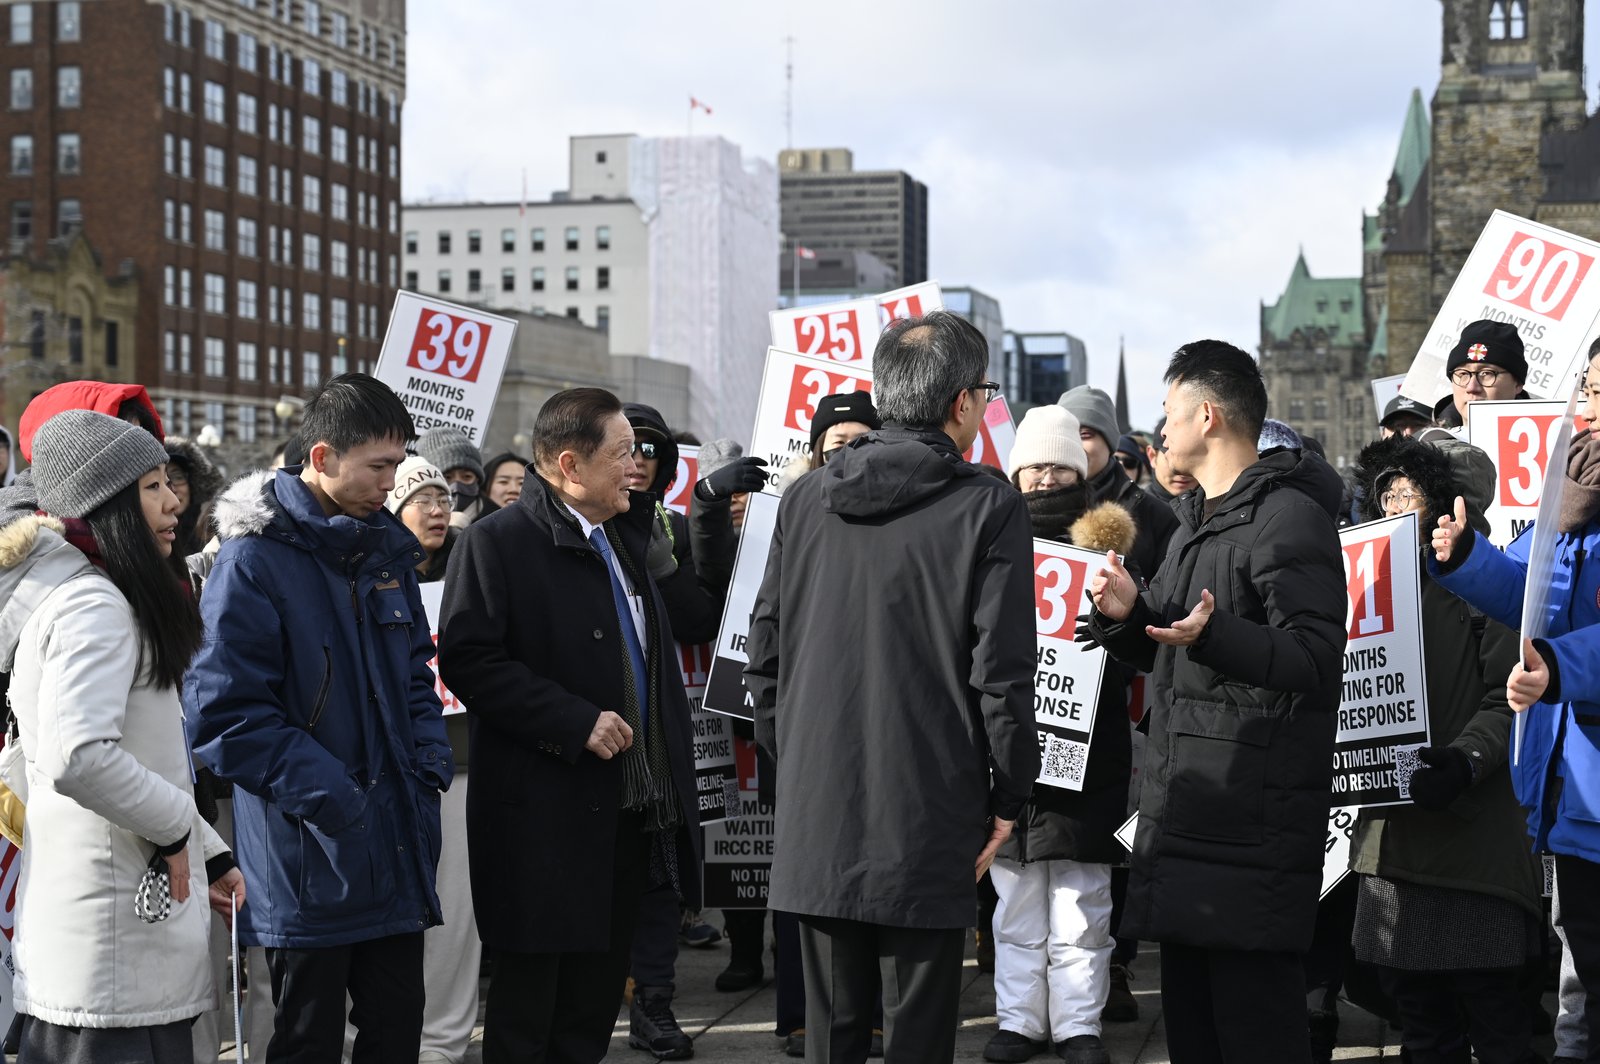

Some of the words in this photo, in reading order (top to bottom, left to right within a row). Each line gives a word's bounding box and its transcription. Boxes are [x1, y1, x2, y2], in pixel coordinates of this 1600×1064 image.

[1496, 237, 1580, 314] 90
[417, 313, 481, 379] 39
[800, 310, 856, 362] 25
[1524, 342, 1553, 366] FOR
[407, 376, 465, 402] MONTHS
[447, 404, 475, 422] FOR
[1035, 670, 1075, 695] FOR
[1375, 672, 1406, 697] FOR
[706, 717, 724, 736] FOR
[1339, 699, 1417, 731] RESPONSE
[1331, 774, 1348, 793] NO
[1349, 769, 1401, 792] RESULTS
[699, 792, 725, 811] ESULTS
[714, 840, 750, 856] IRCC
[731, 868, 750, 883] NO
[737, 885, 756, 899] NO
